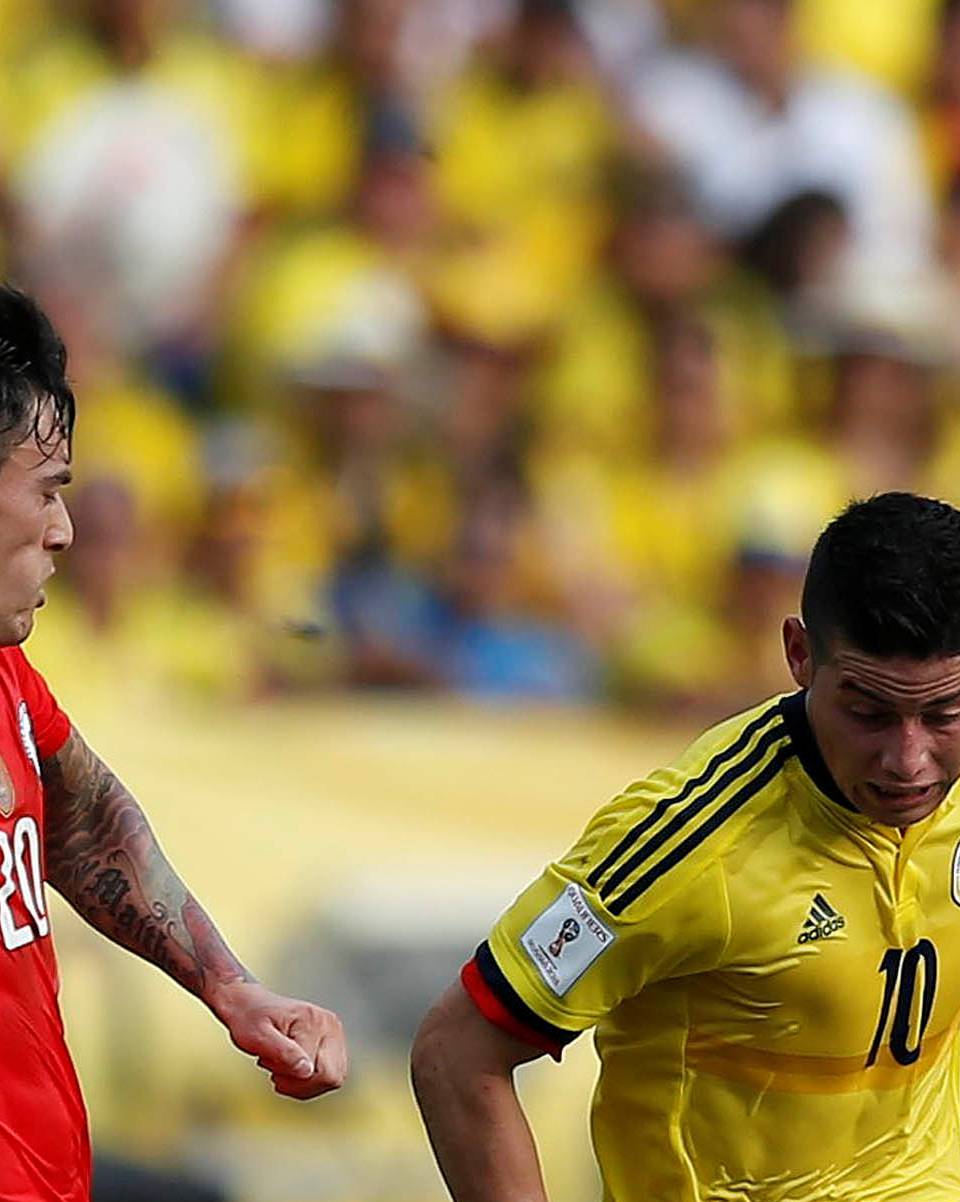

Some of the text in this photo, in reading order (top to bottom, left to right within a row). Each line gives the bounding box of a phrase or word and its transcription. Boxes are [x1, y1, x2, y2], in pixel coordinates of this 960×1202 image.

[0, 816, 48, 951] 20
[797, 915, 845, 944] adidas
[865, 938, 937, 1066] 10
